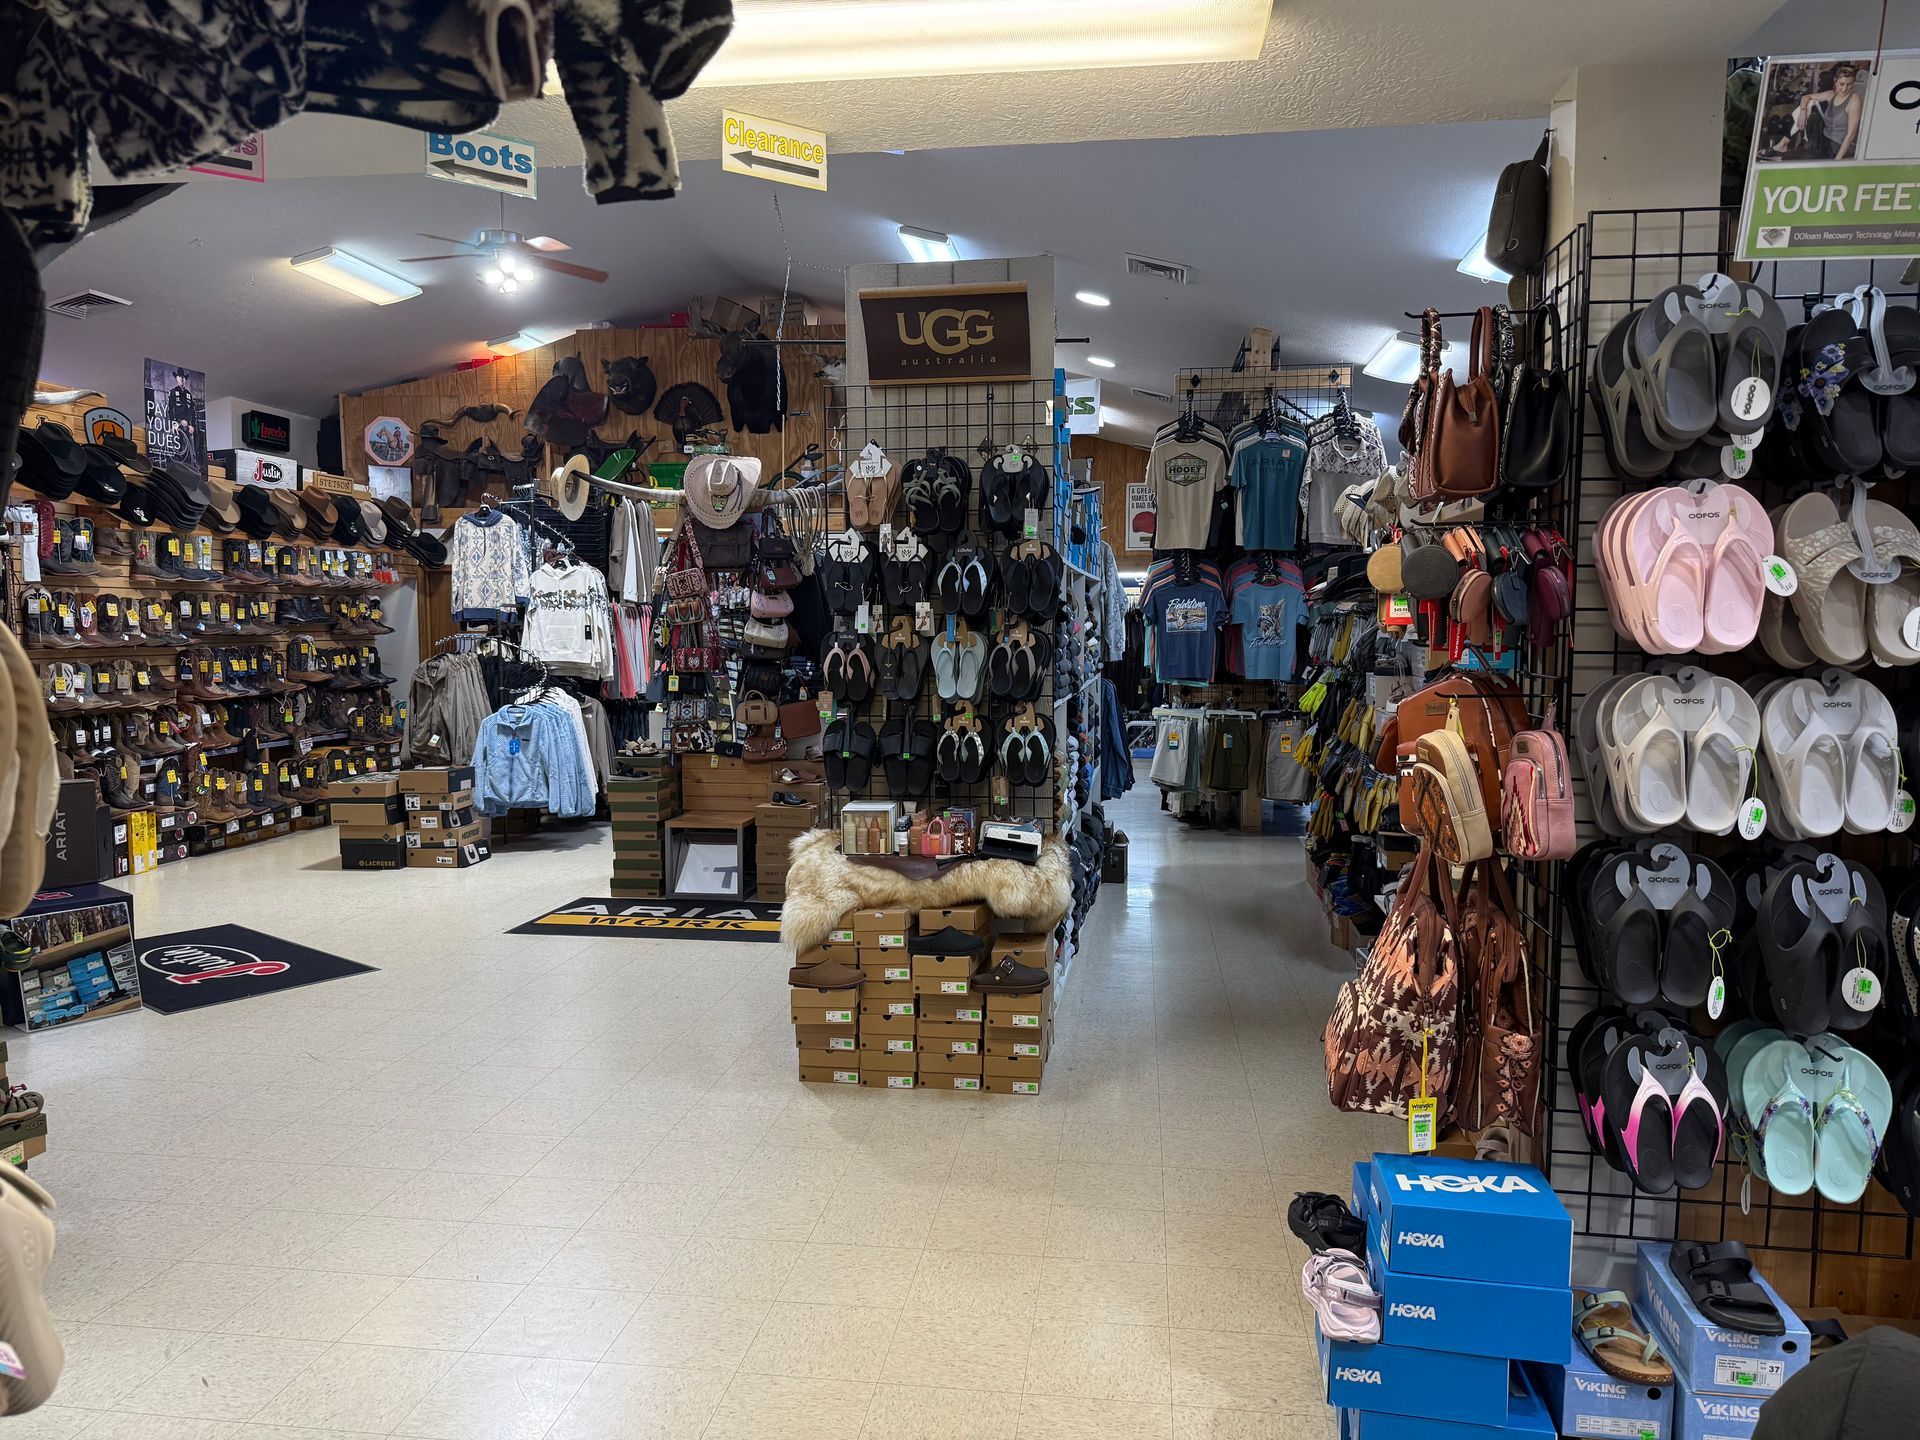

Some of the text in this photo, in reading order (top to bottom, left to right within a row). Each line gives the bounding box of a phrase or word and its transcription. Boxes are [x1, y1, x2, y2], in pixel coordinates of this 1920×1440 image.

[724, 117, 824, 164] Clearance
[429, 131, 533, 173] Boots
[1763, 182, 1920, 214] YOUR FEE
[1823, 231, 1853, 241] Recovery
[1856, 230, 1892, 240] Technology
[1894, 229, 1915, 239] Makes
[896, 308, 994, 355] UGG
[901, 354, 996, 366] australia
[147, 401, 168, 418] PAY
[147, 415, 180, 435] YOUR
[260, 422, 287, 439] Laredo
[148, 431, 181, 450] DUES
[253, 458, 283, 483] Justin
[1169, 466, 1202, 474] HOOEY
[319, 477, 350, 490] STETSON
[1688, 511, 1721, 519] OOFOS
[1860, 571, 1894, 579] OOFOS
[56, 809, 67, 861] ARIAT
[1648, 876, 1681, 884] OOFOS
[1818, 888, 1844, 896] OOFOS
[553, 905, 782, 921] ARIA
[588, 917, 752, 929] WORK
[160, 946, 291, 984] Justin
[1655, 1062, 1682, 1070] OOFOS
[1800, 1067, 1834, 1078] OOFOS
[1412, 1103, 1434, 1111] Wrangler
[1394, 1174, 1540, 1194] HOKA
[1398, 1231, 1445, 1249] HOKA
[1389, 1303, 1436, 1321] HOKA
[1335, 1366, 1382, 1385] HOKA
[1768, 1365, 1780, 1373] 37
